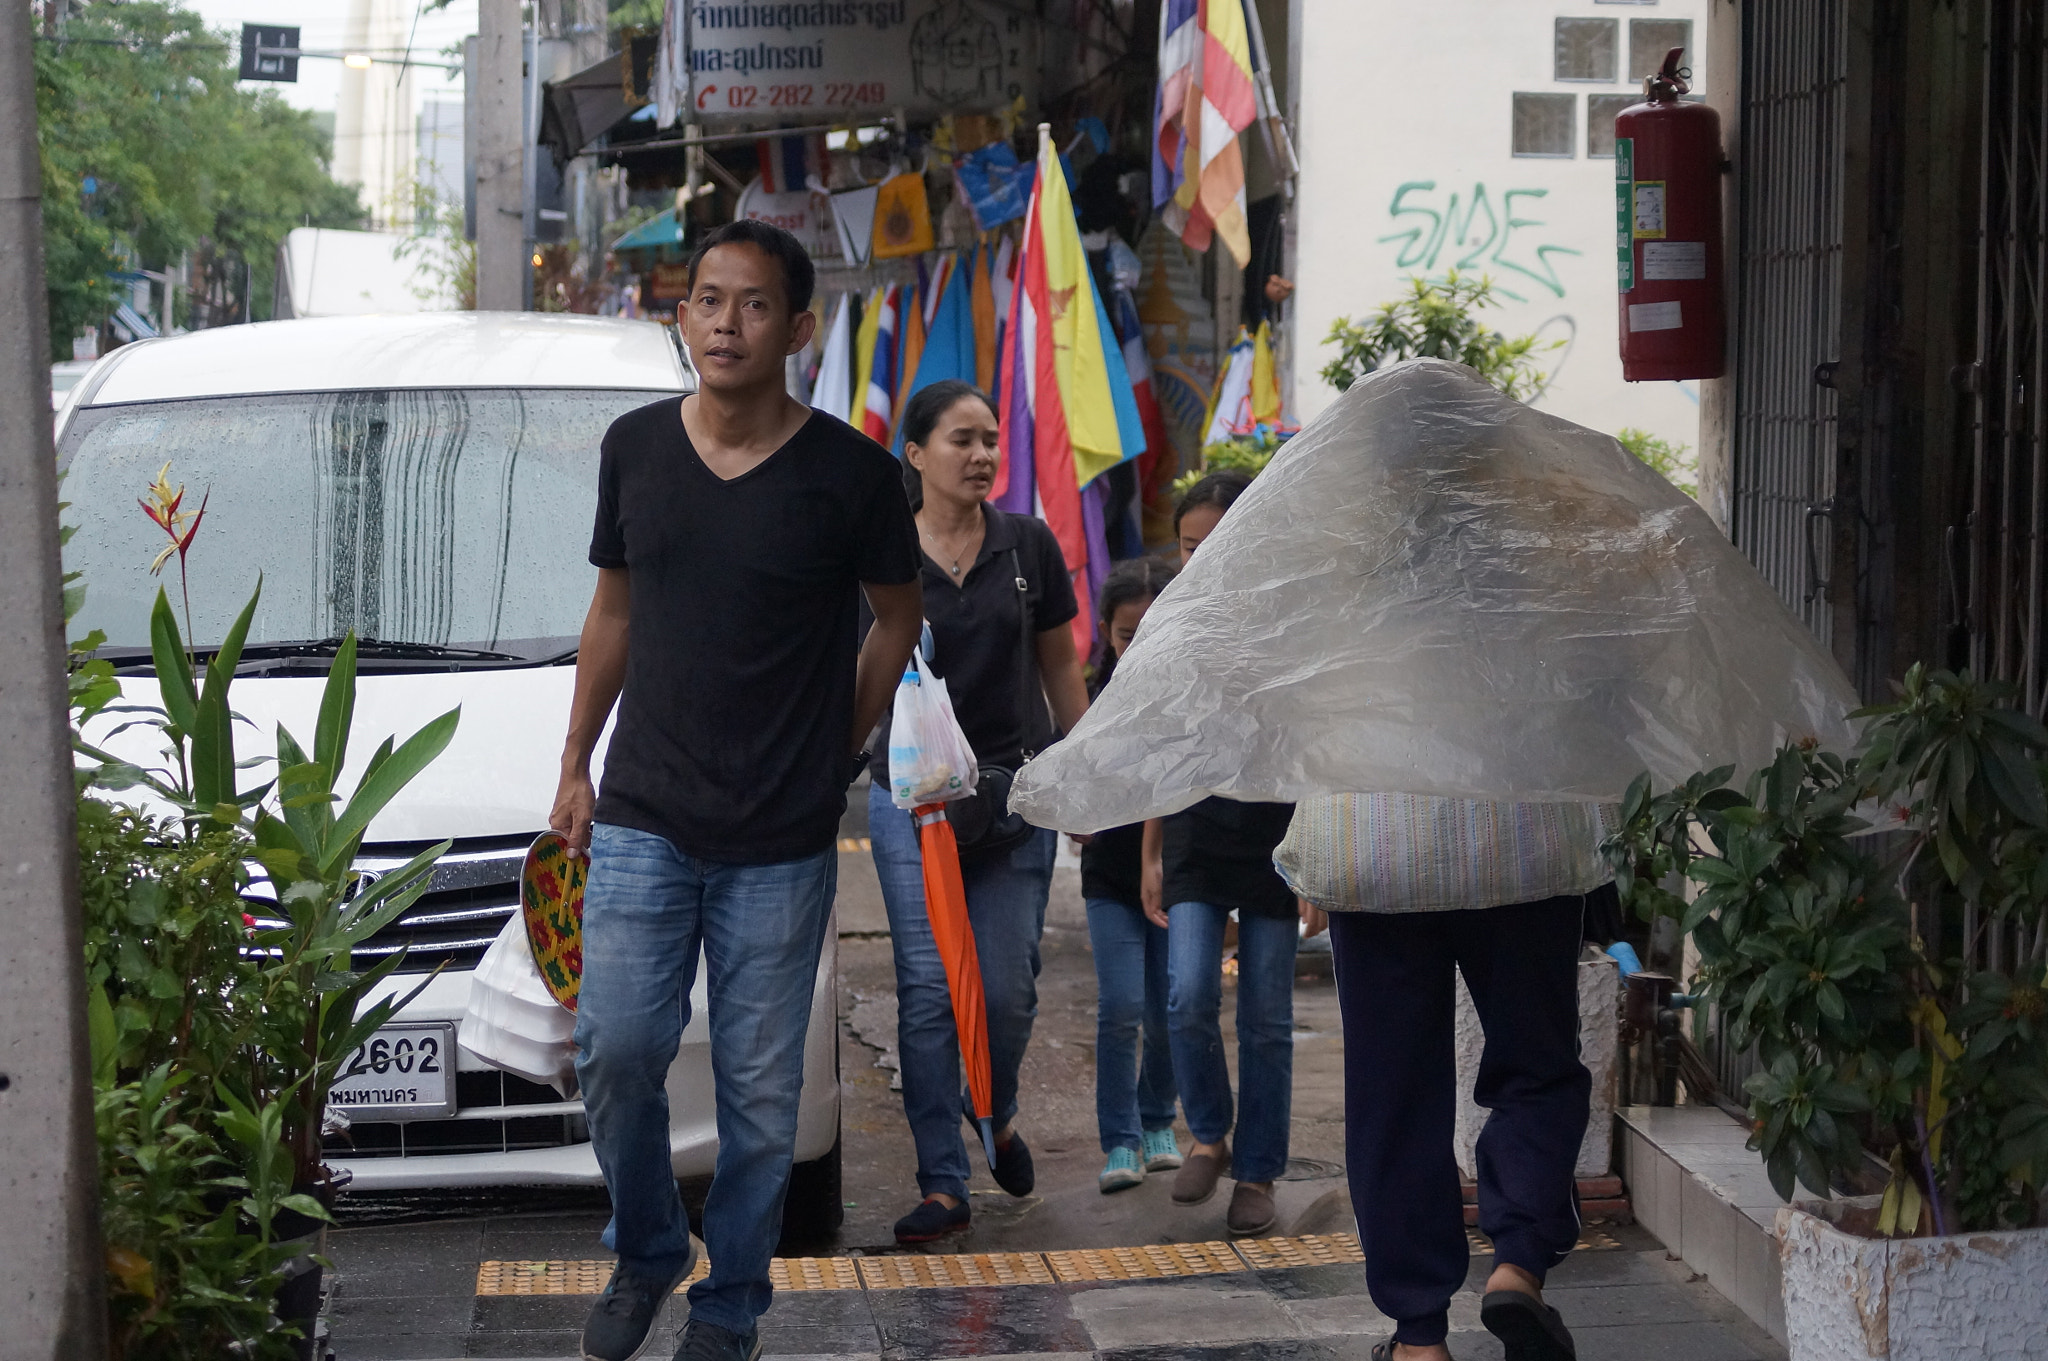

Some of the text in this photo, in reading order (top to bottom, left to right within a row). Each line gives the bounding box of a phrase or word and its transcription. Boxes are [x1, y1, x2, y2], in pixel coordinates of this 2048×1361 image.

[727, 84, 814, 108] 02-282
[346, 1036, 440, 1074] 2602
[326, 1088, 418, 1104] พมหานคร
